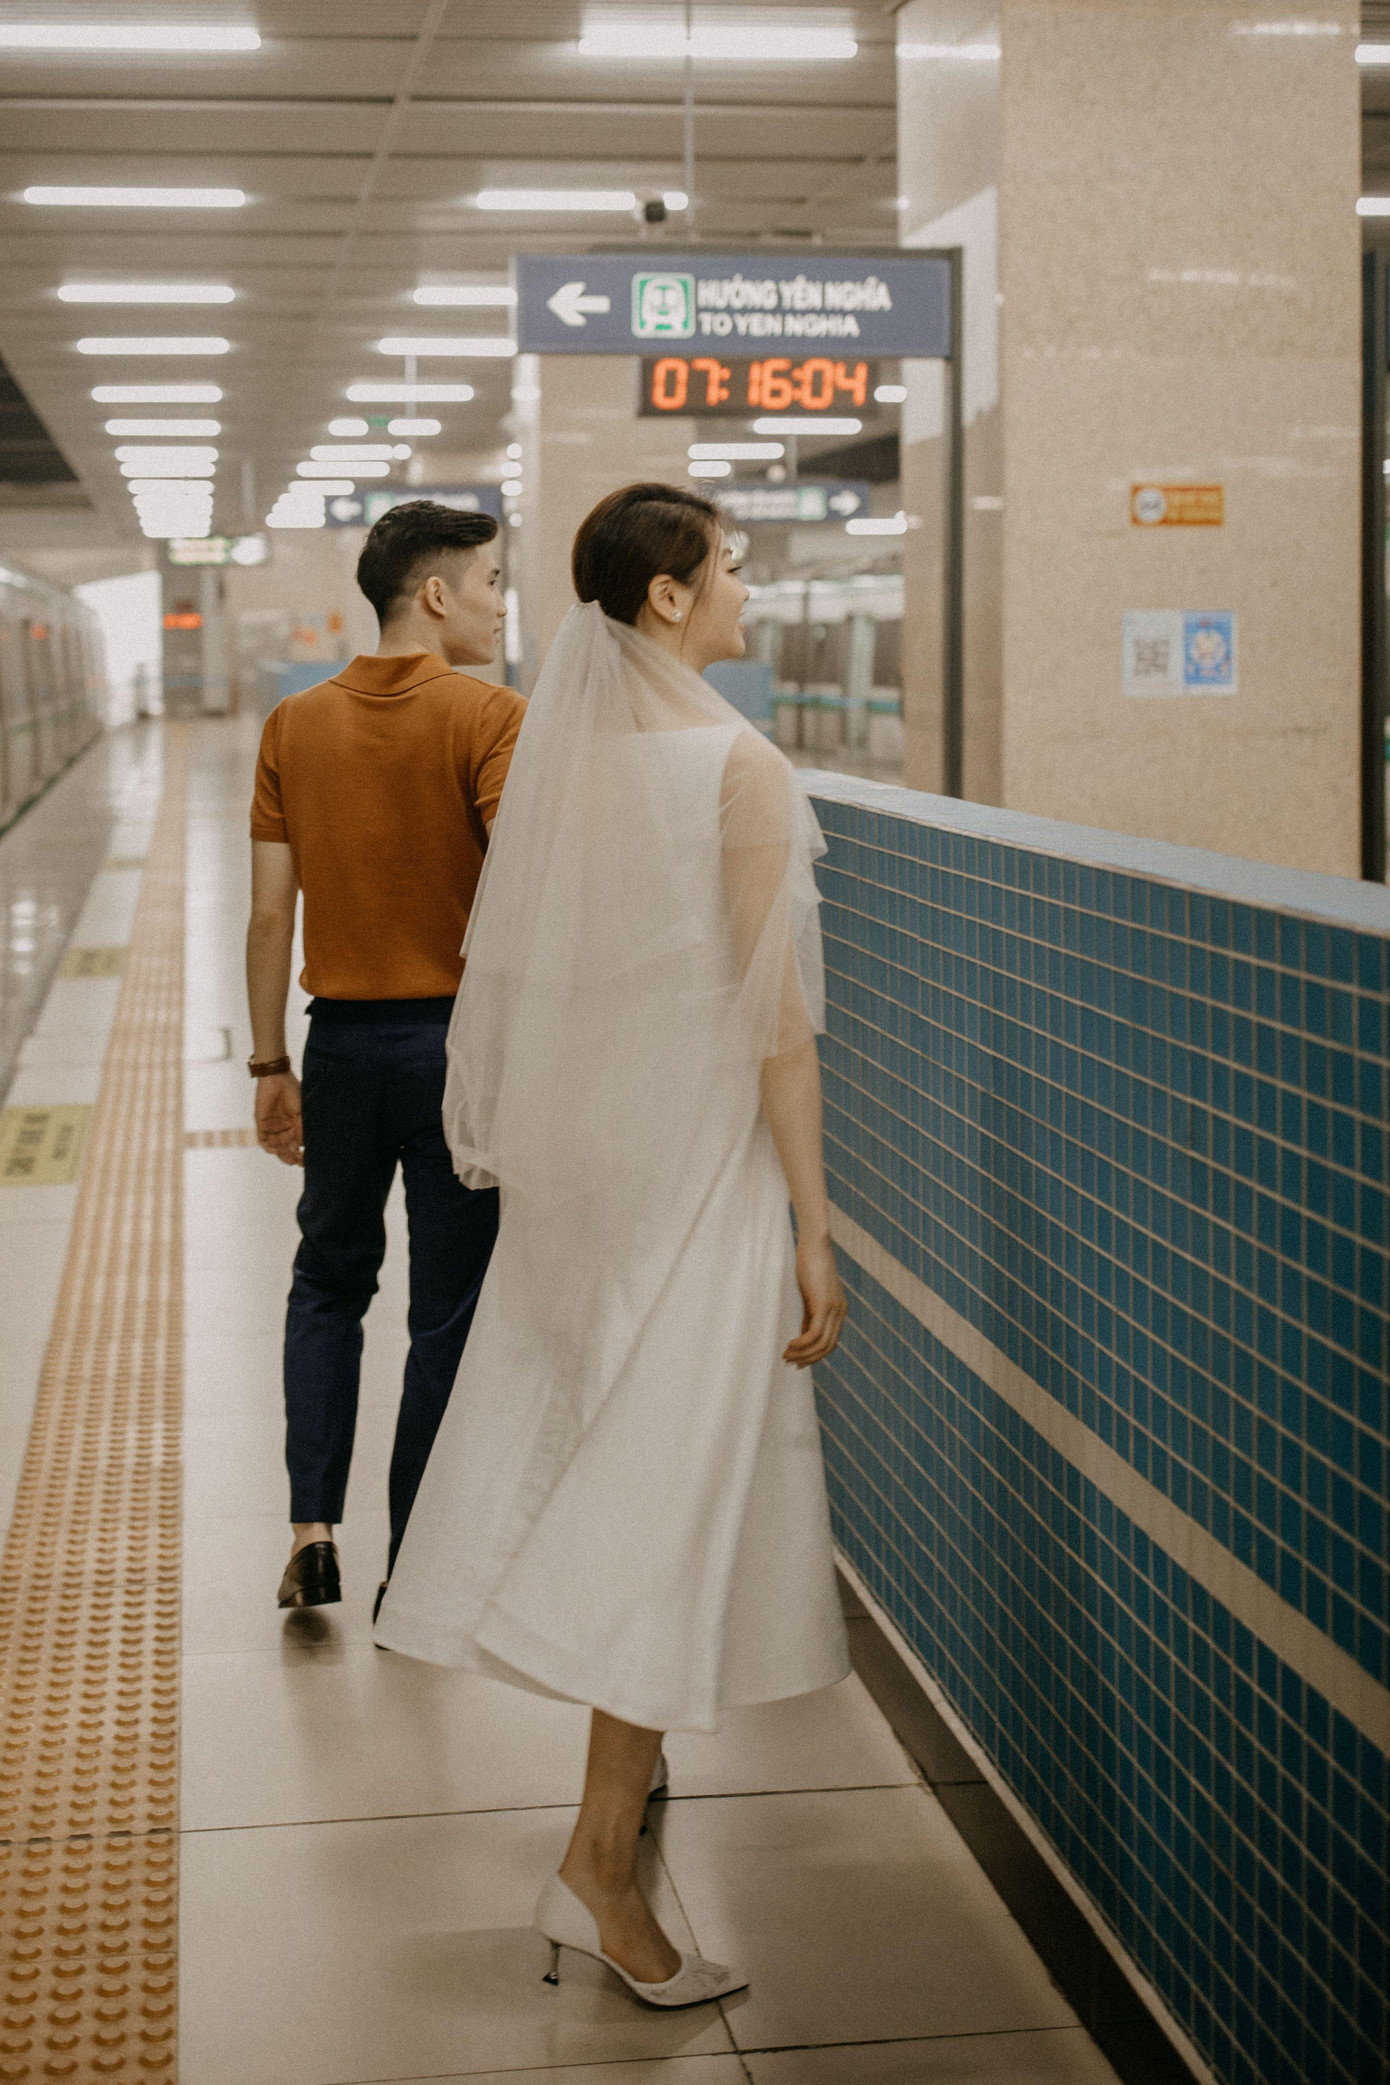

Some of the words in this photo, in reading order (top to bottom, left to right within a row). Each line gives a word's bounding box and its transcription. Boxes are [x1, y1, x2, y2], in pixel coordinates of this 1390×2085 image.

[779, 274, 823, 311] YÊN
[698, 312, 733, 337] TO
[733, 312, 783, 337] YEN
[783, 312, 861, 338] NGHIA
